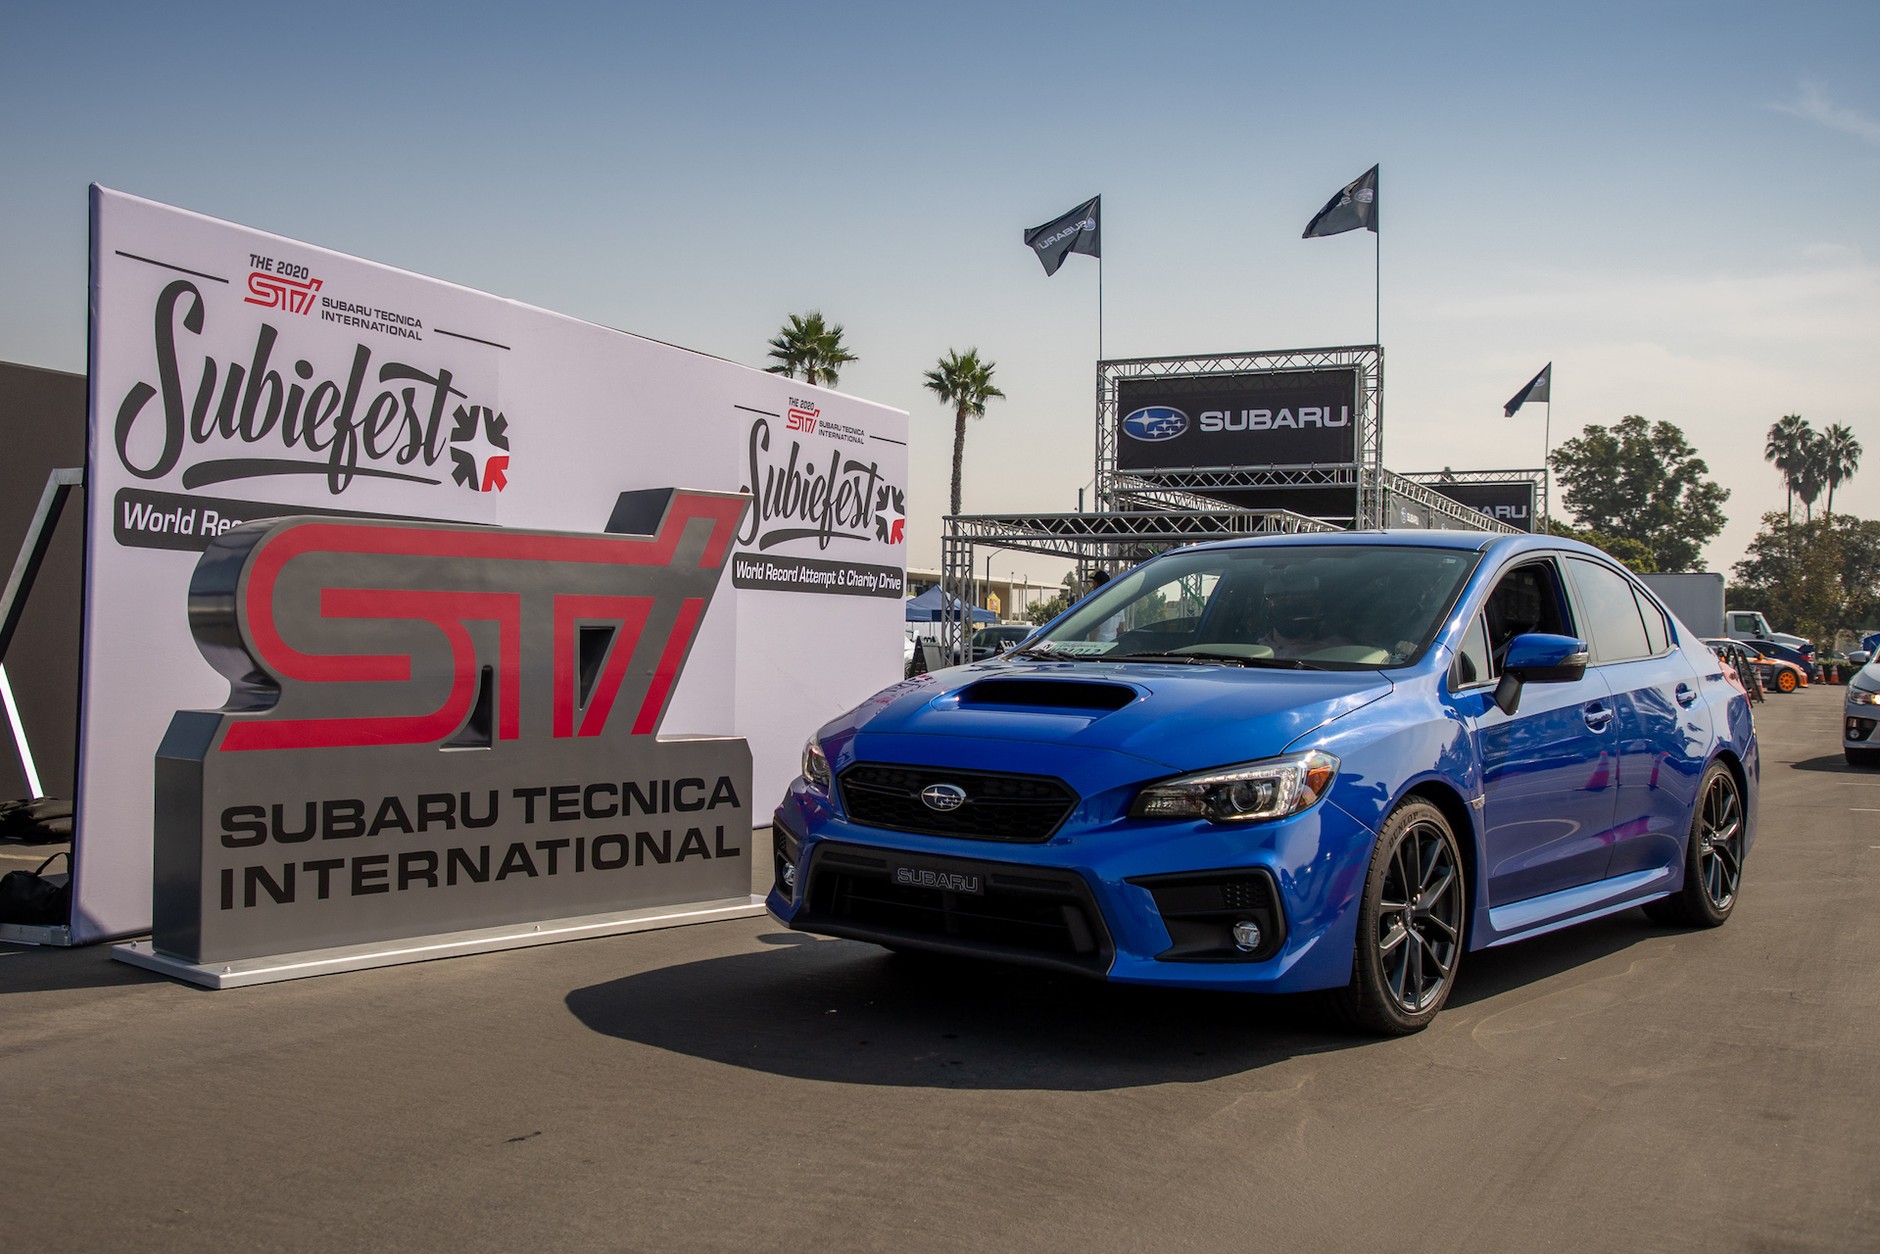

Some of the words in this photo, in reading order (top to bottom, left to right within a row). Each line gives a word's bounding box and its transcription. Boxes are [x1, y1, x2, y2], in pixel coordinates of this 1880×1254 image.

[250, 254, 274, 271] THE
[277, 261, 309, 280] 2020
[321, 310, 422, 341] INTERNATIONAL
[322, 297, 372, 317] SUBARU
[374, 309, 423, 329] TECNICA
[115, 279, 467, 495] Subiefest
[789, 396, 800, 408] THE
[800, 400, 815, 411] 2020
[1200, 405, 1349, 432] SUBARU
[818, 429, 865, 445] INTERNATIONAL
[819, 420, 841, 432] SUBARU
[842, 425, 865, 437] TECNICA
[736, 418, 885, 551] Subiefest
[123, 501, 197, 536] World
[736, 560, 765, 580] World
[765, 563, 799, 582] Record
[799, 566, 836, 589] Attempt
[837, 569, 845, 585] &
[846, 570, 878, 592] Charity
[878, 573, 901, 591] Drive
[220, 789, 500, 849] SUBARU
[513, 775, 742, 825] TECNICA
[1388, 811, 1419, 848] DUNLOP
[219, 825, 741, 911] INTERNATIONAL
[897, 867, 978, 892] SUBARU
